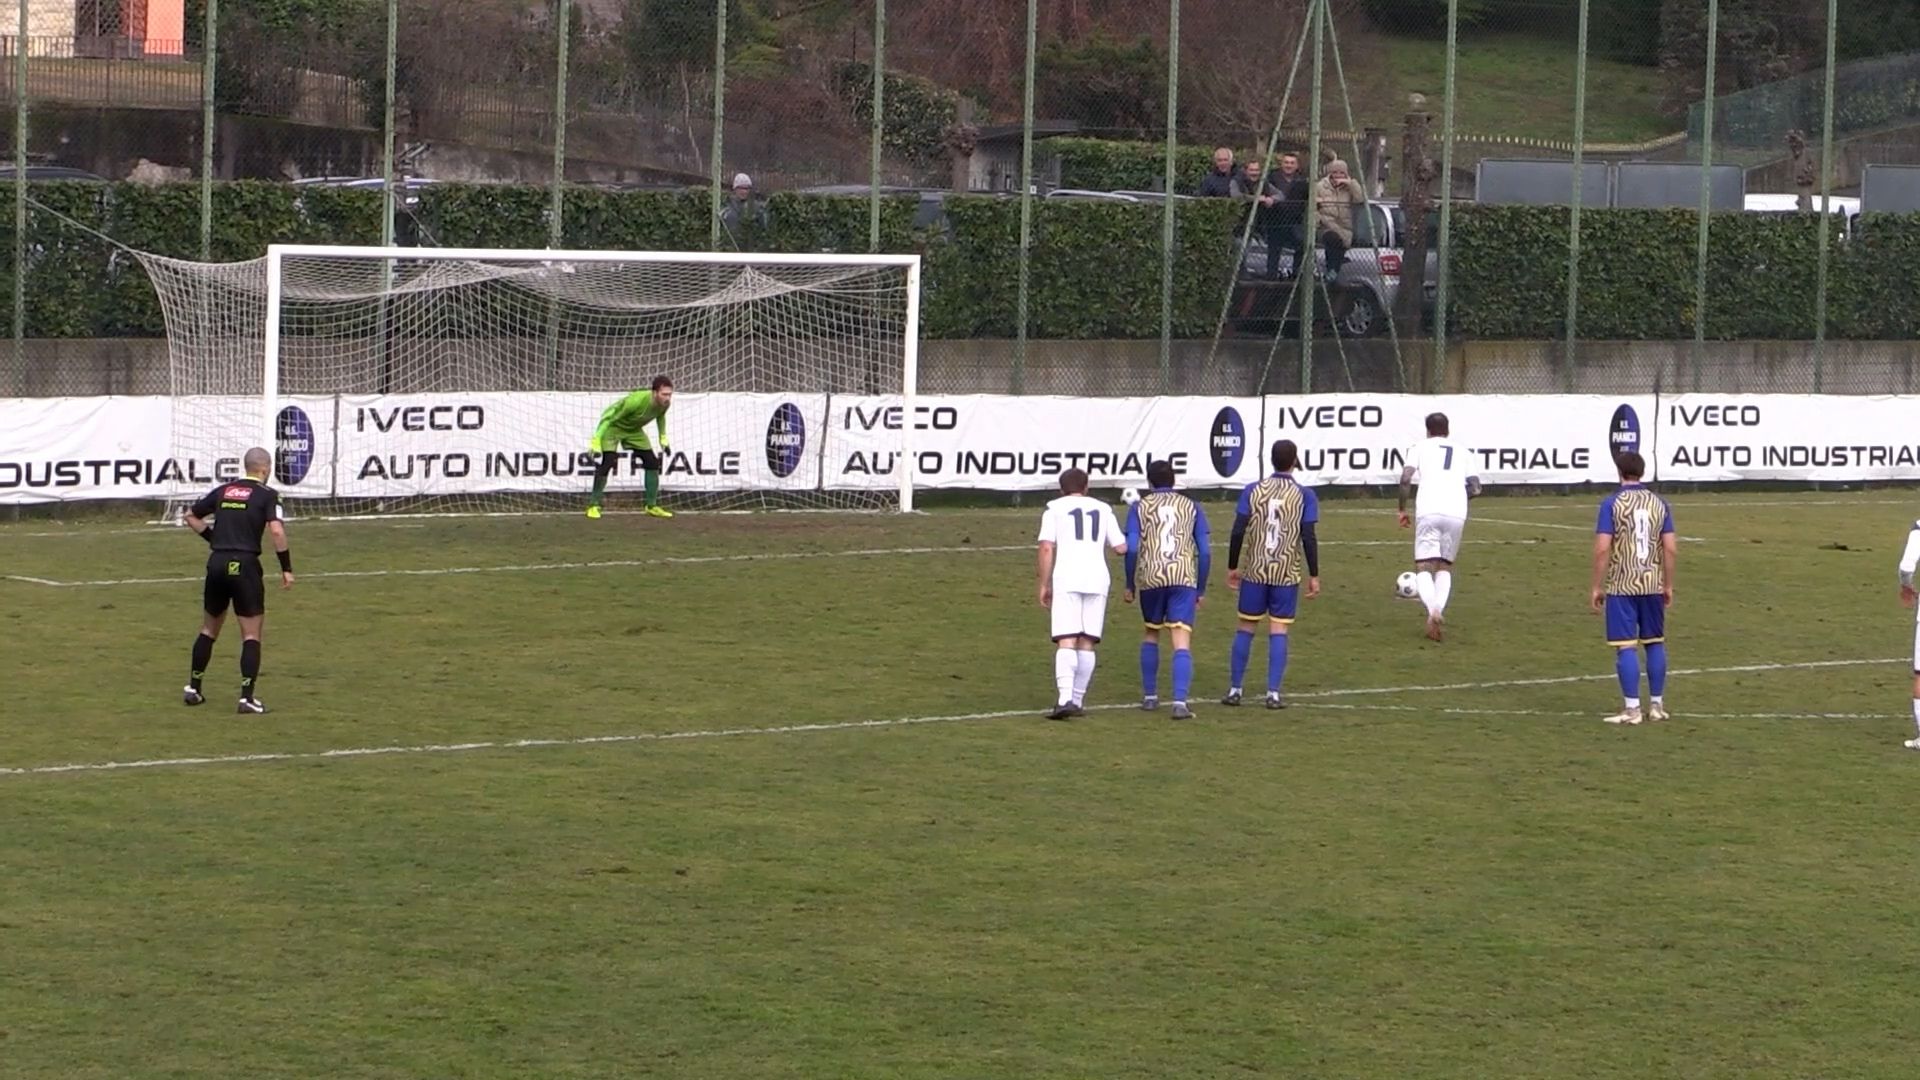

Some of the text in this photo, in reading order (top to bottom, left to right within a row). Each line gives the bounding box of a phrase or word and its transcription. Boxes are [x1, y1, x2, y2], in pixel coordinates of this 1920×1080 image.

[357, 405, 485, 433] IVECO
[1278, 405, 1383, 429] IVECO
[1670, 405, 1760, 426] IVECO
[1213, 435, 1241, 448] PIANICO
[357, 453, 470, 481] AUTO
[842, 450, 943, 475] AUO
[1295, 448, 1370, 471] UTO
[1439, 445, 1453, 470] 7
[1671, 445, 1920, 467] AUTO INDUSTRIA
[1068, 507, 1100, 542] 11
[1633, 508, 1650, 561] 9
